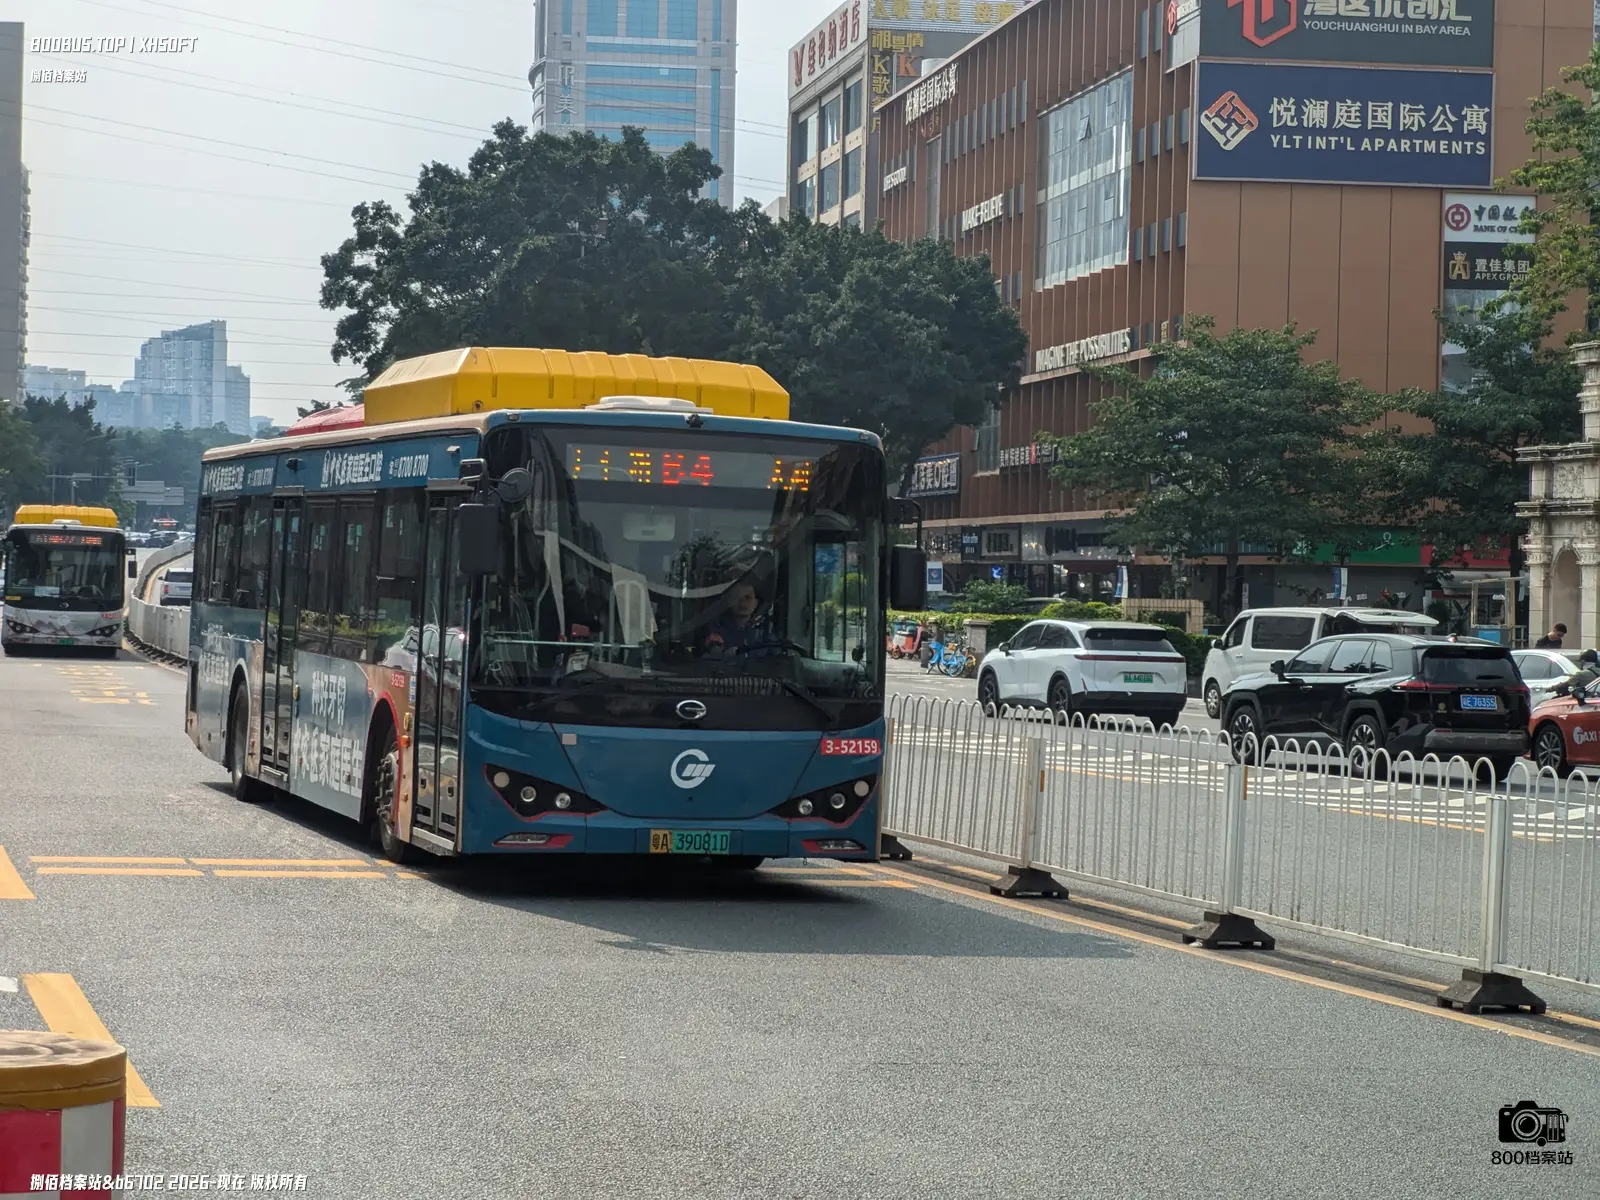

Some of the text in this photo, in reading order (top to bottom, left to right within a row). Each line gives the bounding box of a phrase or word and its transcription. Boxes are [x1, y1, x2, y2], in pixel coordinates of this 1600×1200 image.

[1304, 20, 1471, 36] YOUCHUANGHUI IN BAY AREA
[872, 30, 924, 53] 湘粤情
[897, 56, 919, 77] K
[1269, 97, 1490, 135] 悦澜庭国际公寓
[1270, 134, 1486, 155] YLT INT'L APARTMENTS
[1474, 204, 1536, 221] 中国银
[1473, 224, 1496, 233] BANK
[1497, 225, 1508, 233] OF
[1474, 258, 1530, 273] 置佳集团
[1474, 272, 1498, 281] APEX
[825, 739, 879, 754] 3-52159
[676, 831, 730, 851] 39081D
